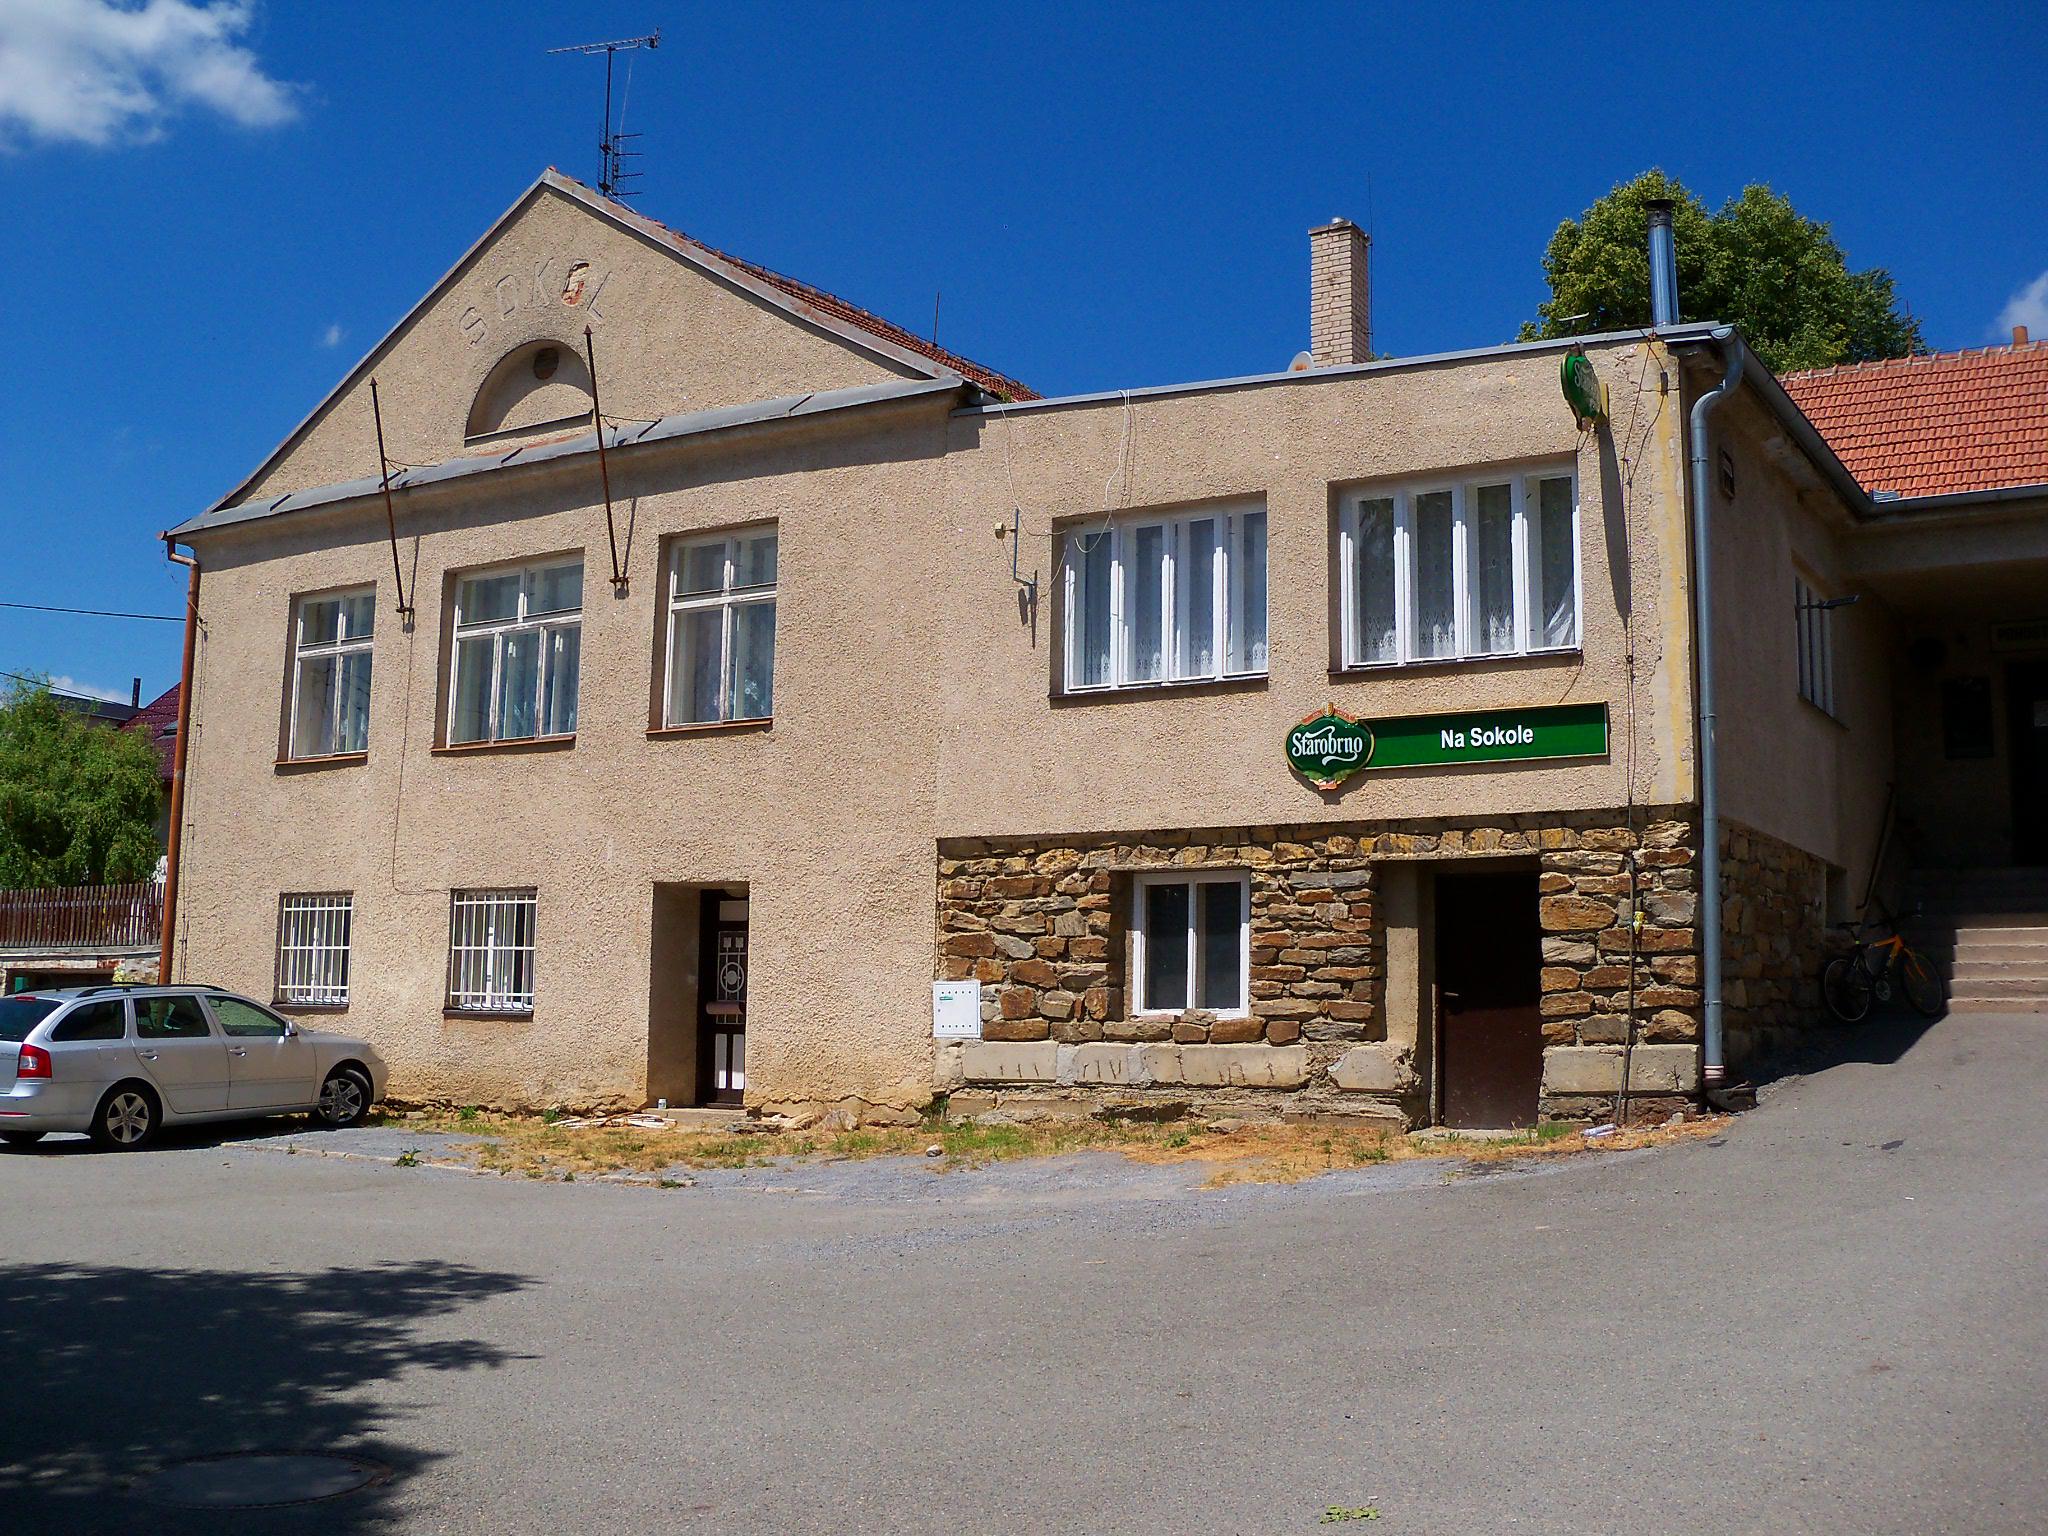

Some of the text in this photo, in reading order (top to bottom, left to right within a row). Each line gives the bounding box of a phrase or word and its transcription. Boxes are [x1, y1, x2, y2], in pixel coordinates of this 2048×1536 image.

[458, 256, 613, 348] SOKOL
[1291, 725, 1363, 767] Starobrno
[1441, 724, 1534, 749] Na Sokole
